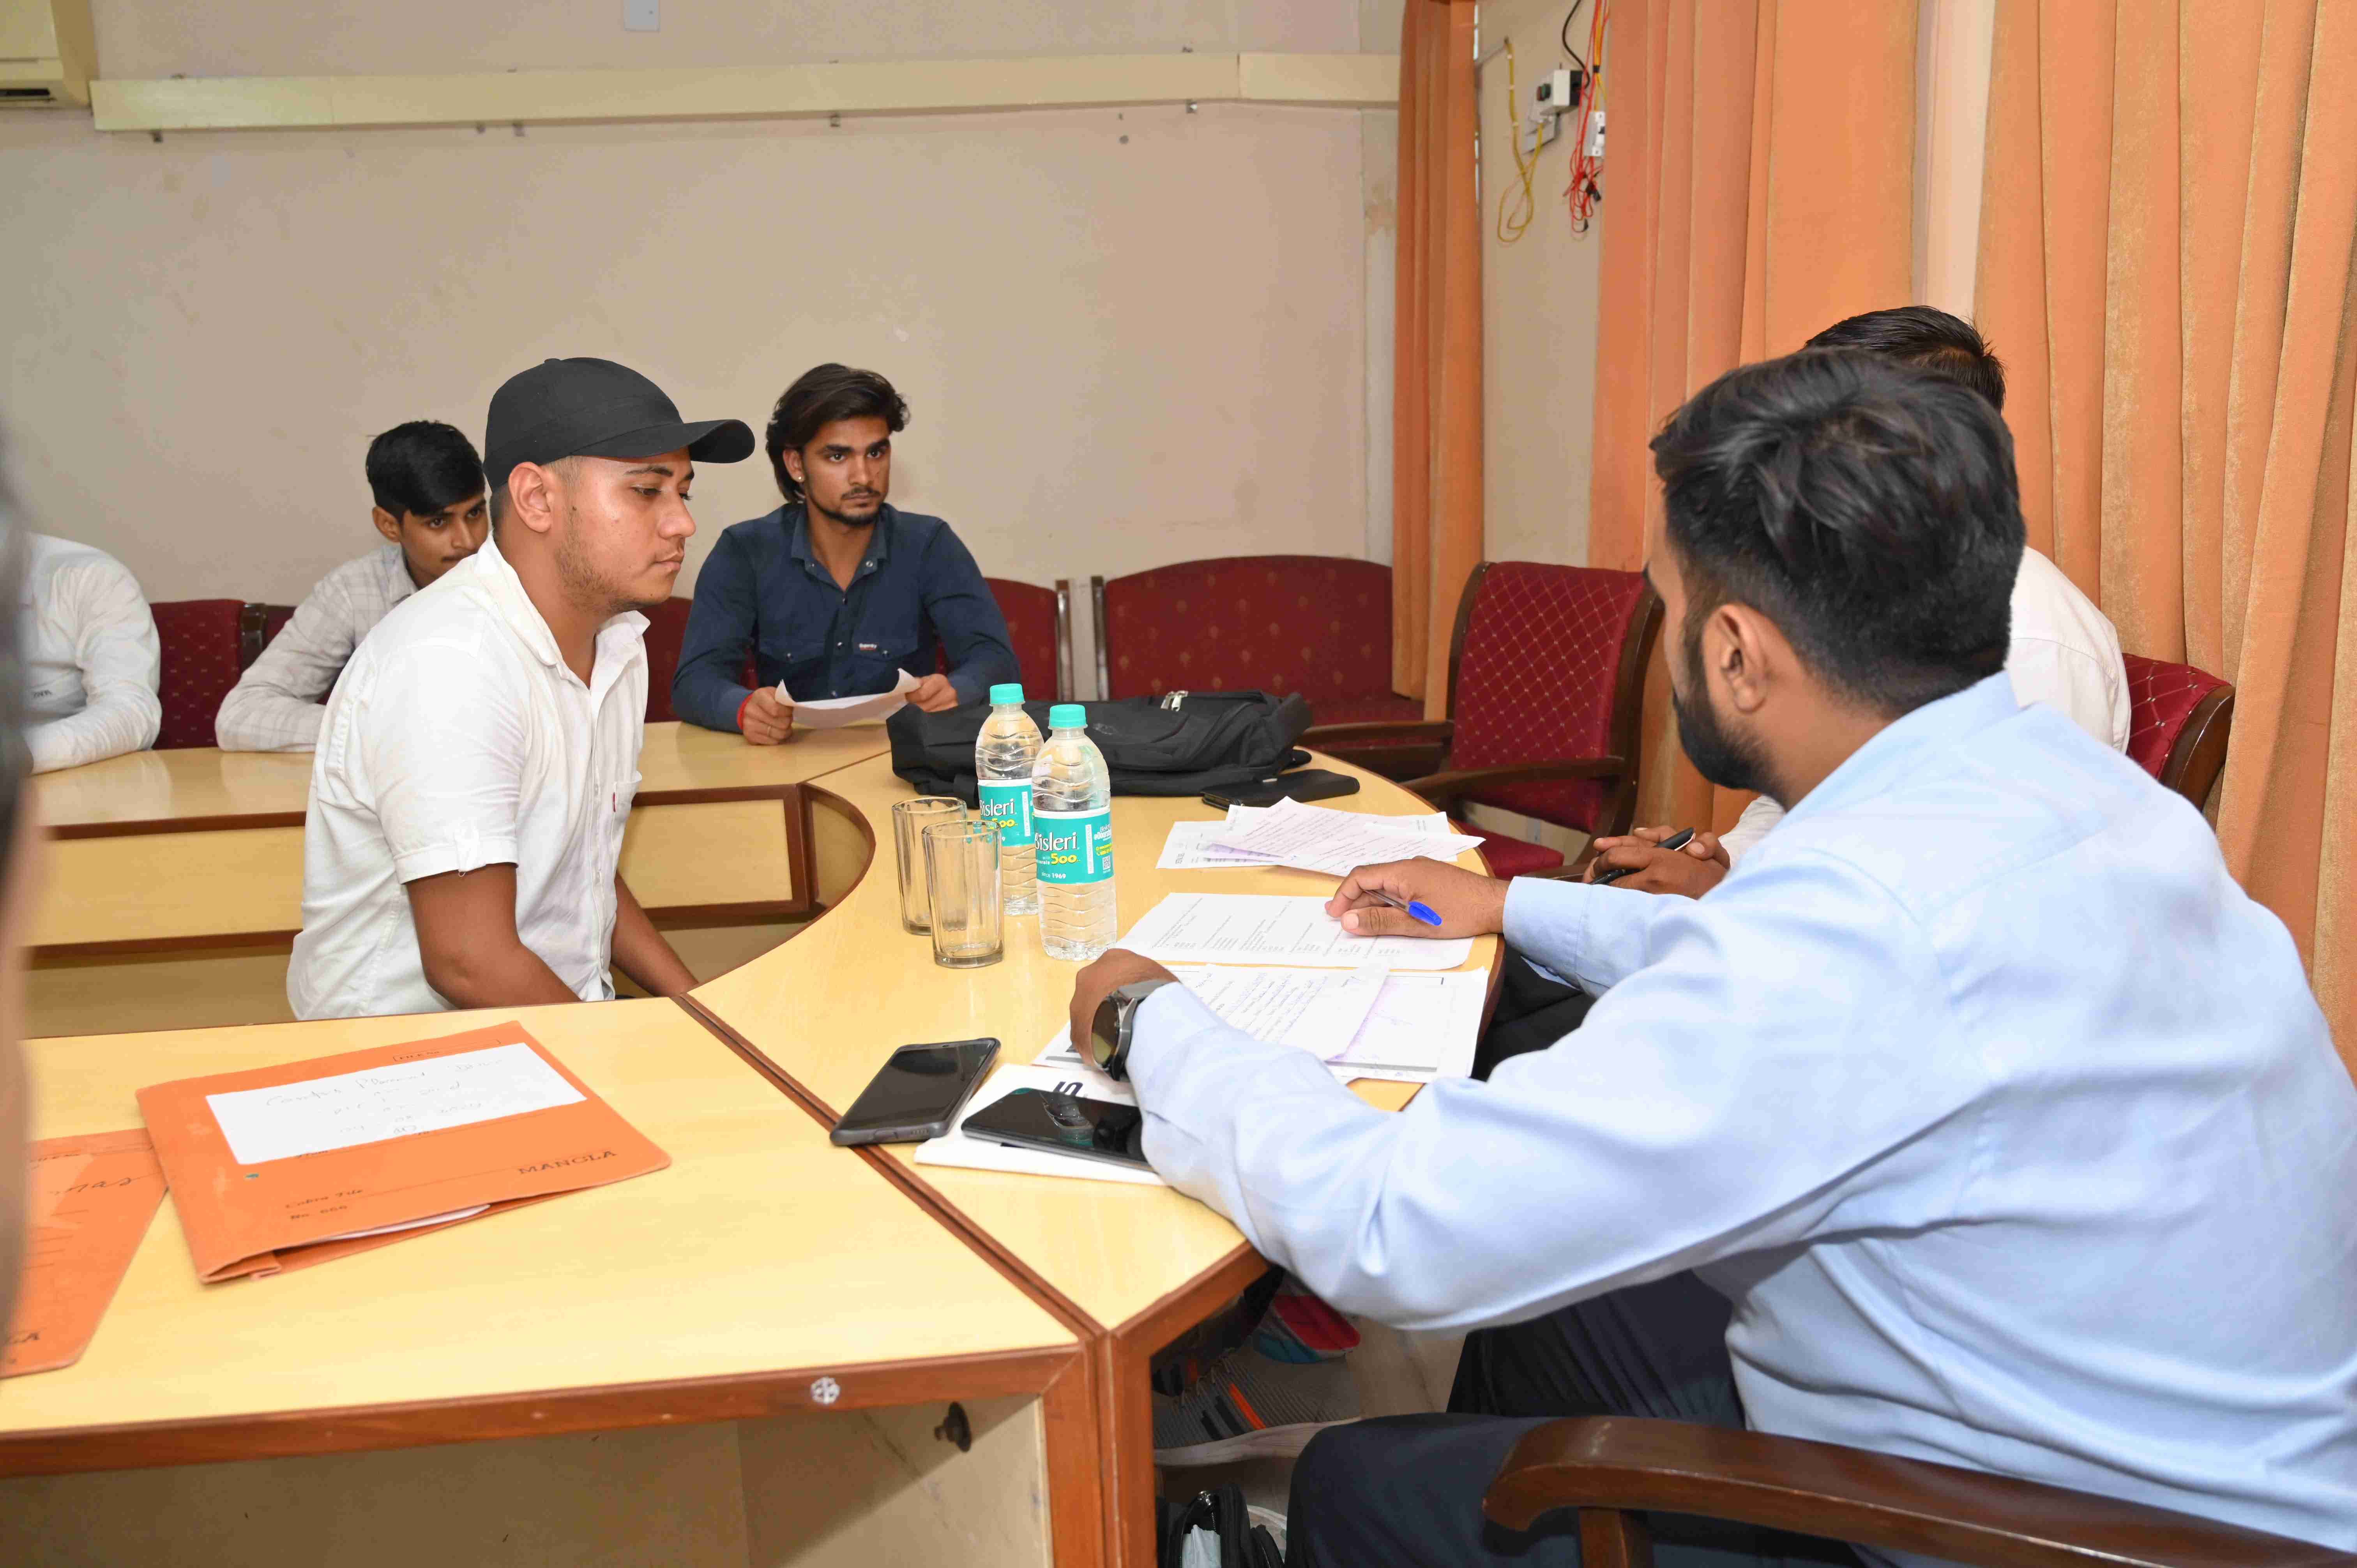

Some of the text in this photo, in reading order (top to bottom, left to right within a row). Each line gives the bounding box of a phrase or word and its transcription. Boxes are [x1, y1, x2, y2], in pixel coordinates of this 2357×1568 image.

[979, 798, 1014, 817] Bisleri
[1035, 832, 1077, 851] Bisleri
[1051, 853, 1077, 865] 500
[518, 1150, 617, 1174] MANGLA
